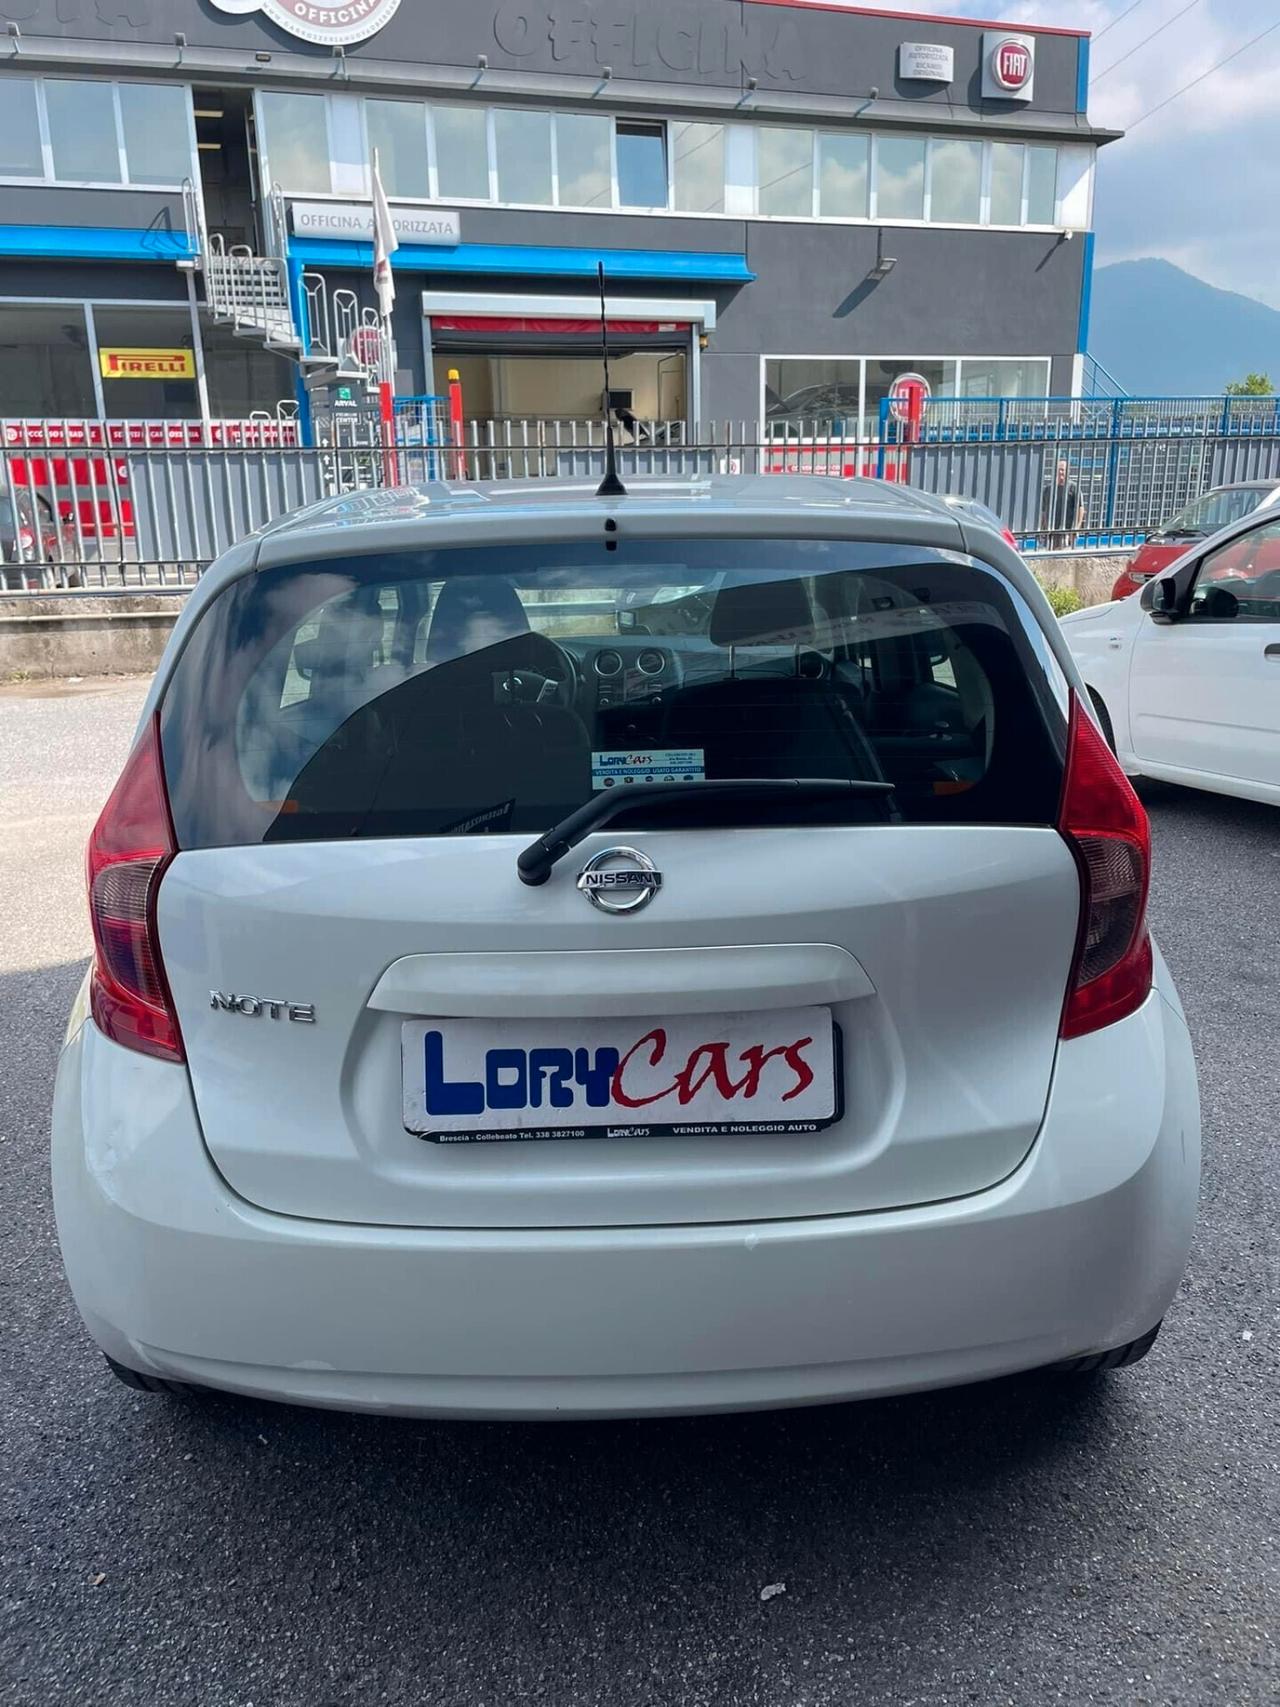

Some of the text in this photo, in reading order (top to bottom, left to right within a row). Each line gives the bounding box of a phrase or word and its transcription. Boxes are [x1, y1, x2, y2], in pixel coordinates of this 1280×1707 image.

[1003, 52, 1028, 77] FIAT
[301, 214, 453, 234] OFFICINA AORIZZATA
[109, 354, 185, 371] PIRELLI
[586, 873, 653, 885] NISSAN
[209, 990, 316, 1023] NOTE
[551, 1130, 585, 1138] 3827100
[730, 1124, 785, 1133] NOLEGGIO
